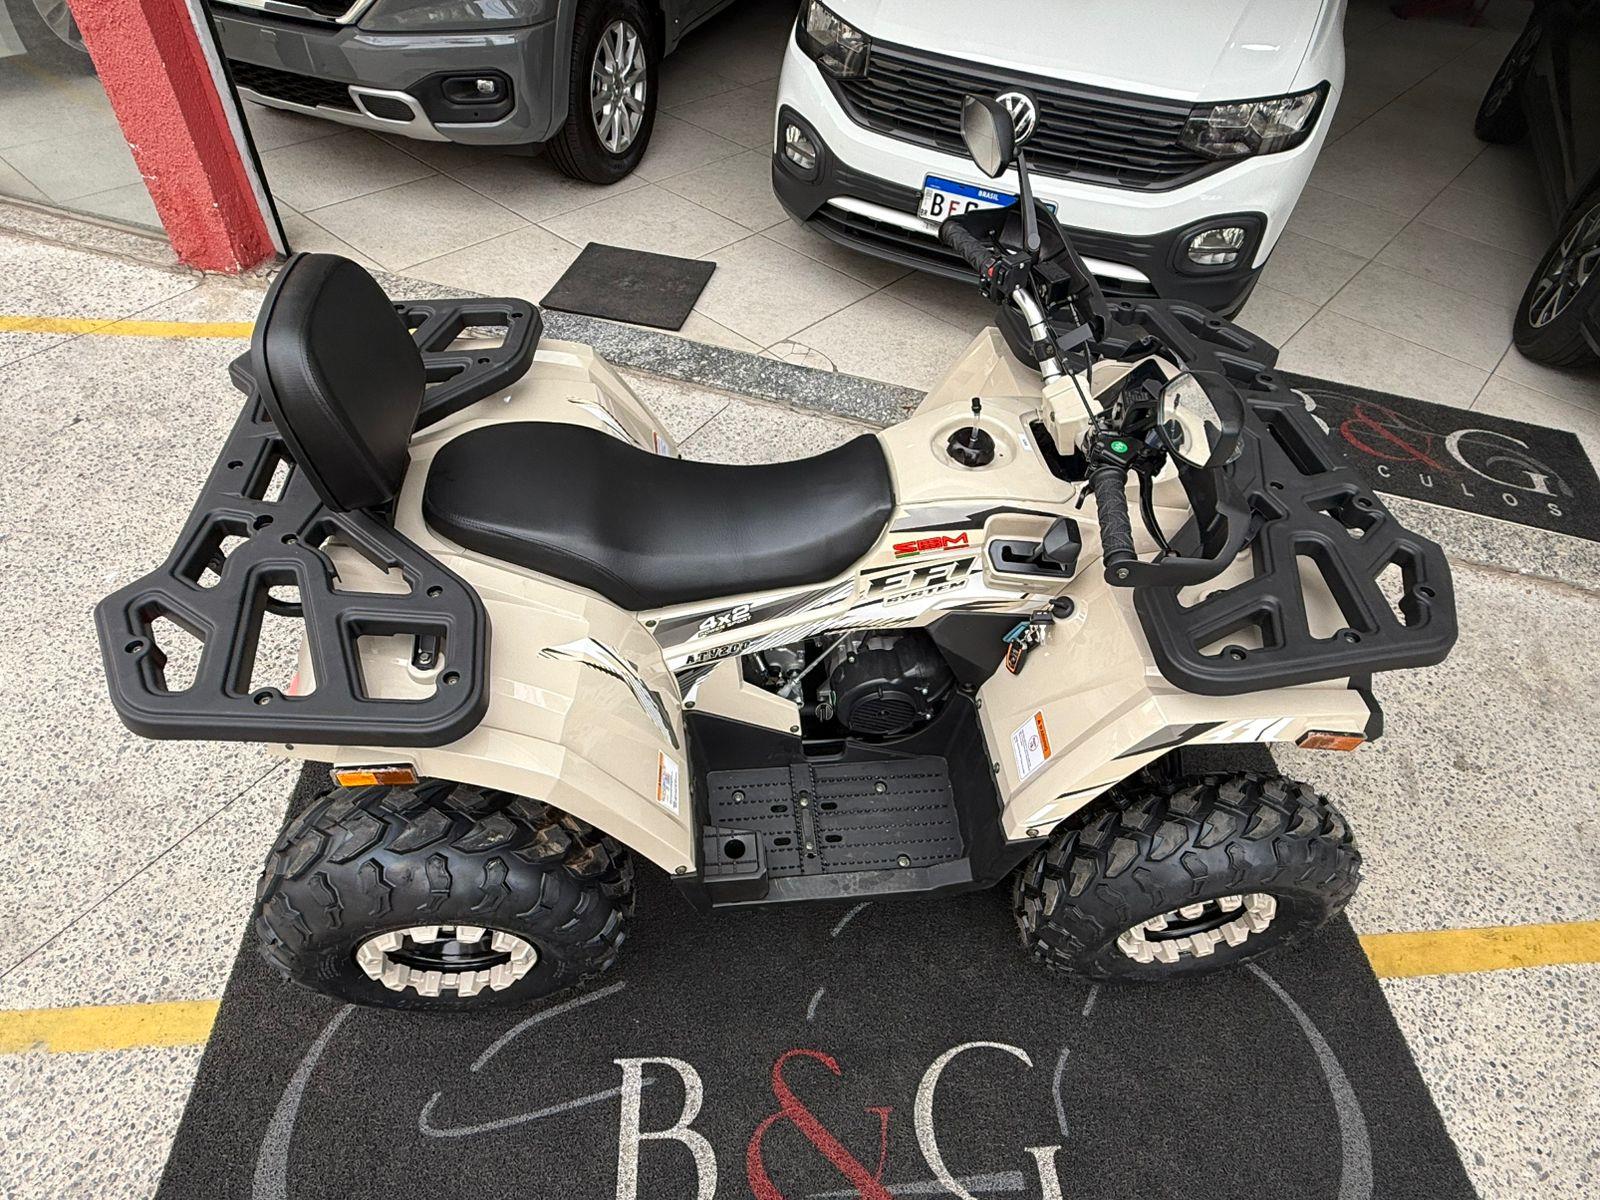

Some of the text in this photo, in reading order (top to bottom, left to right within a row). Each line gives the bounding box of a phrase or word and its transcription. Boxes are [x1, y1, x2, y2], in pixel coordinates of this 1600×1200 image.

[978, 189, 999, 201] BRASIL
[892, 532, 969, 555] SBM
[887, 580, 966, 603] SYSTEM
[686, 641, 751, 664] ATV200
